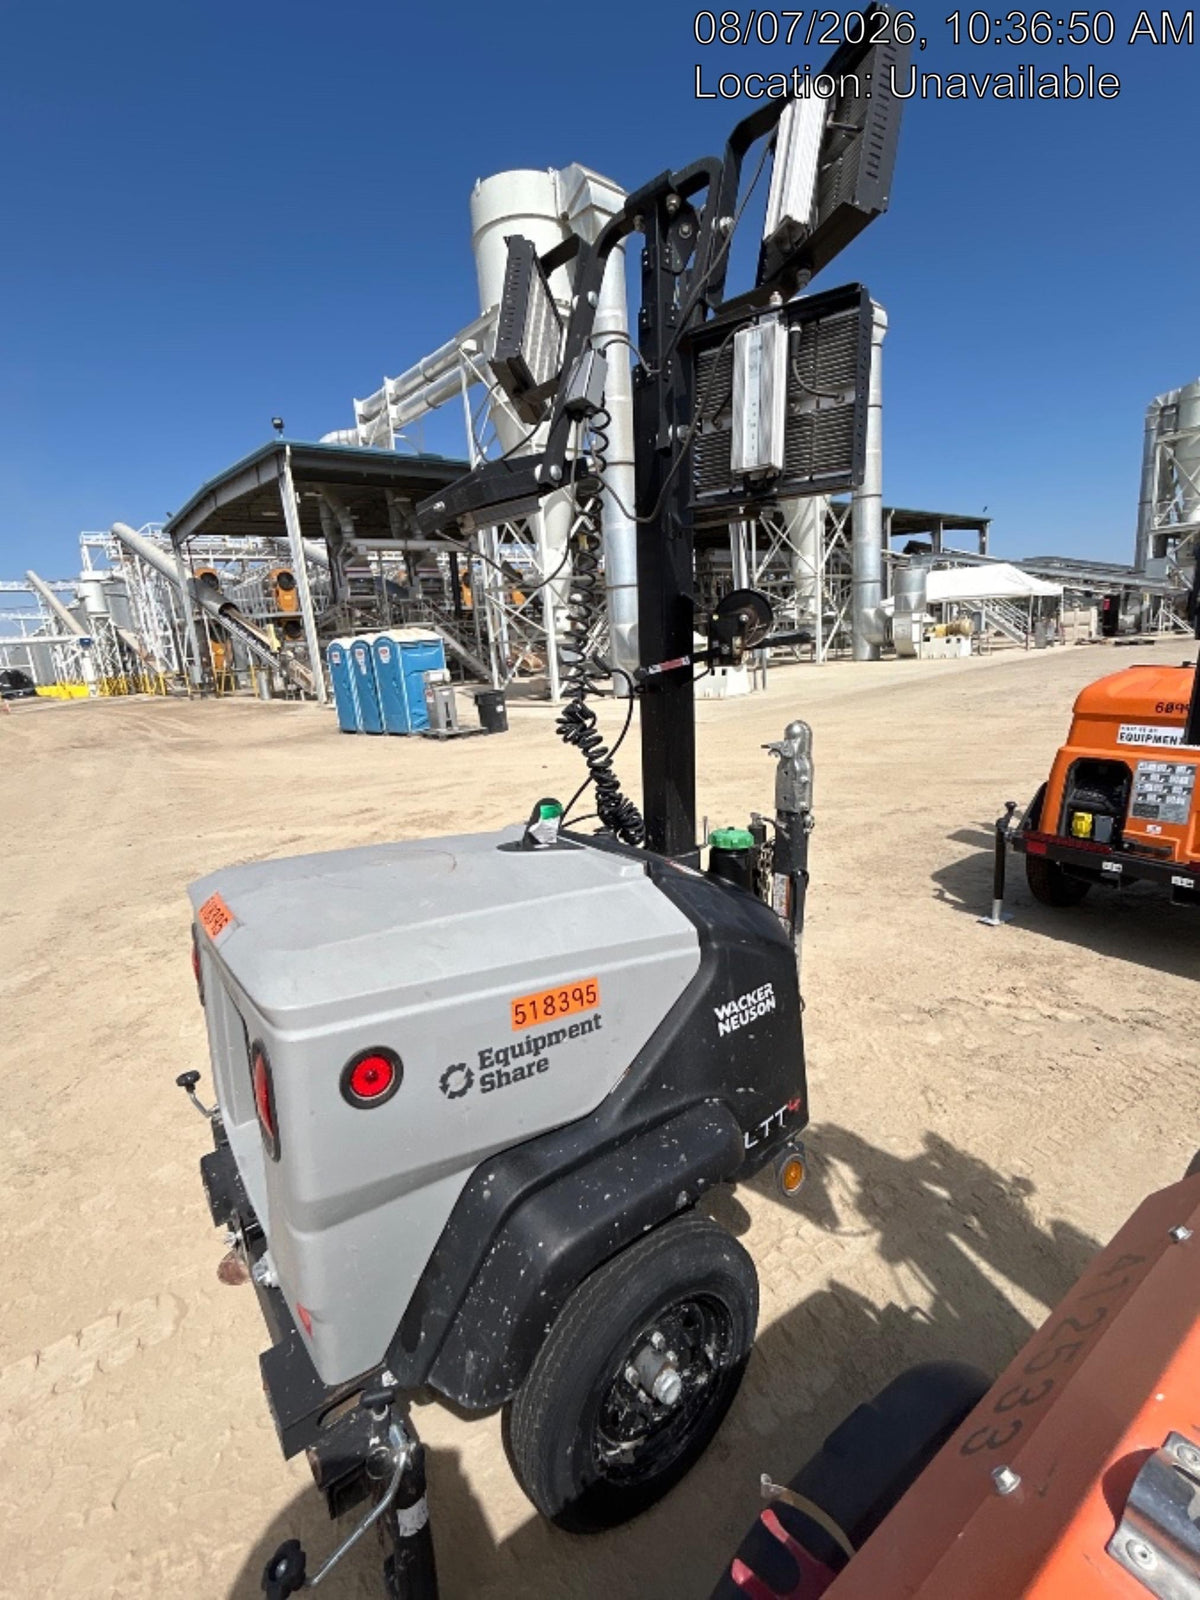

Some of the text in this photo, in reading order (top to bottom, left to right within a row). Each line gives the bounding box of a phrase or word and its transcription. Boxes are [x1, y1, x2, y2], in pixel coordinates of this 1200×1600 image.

[514, 984, 597, 1025] 518395
[713, 982, 774, 1021] WACKER
[718, 995, 776, 1037] NEUSON
[477, 1012, 603, 1070] Equipment
[479, 1057, 550, 1094] Share
